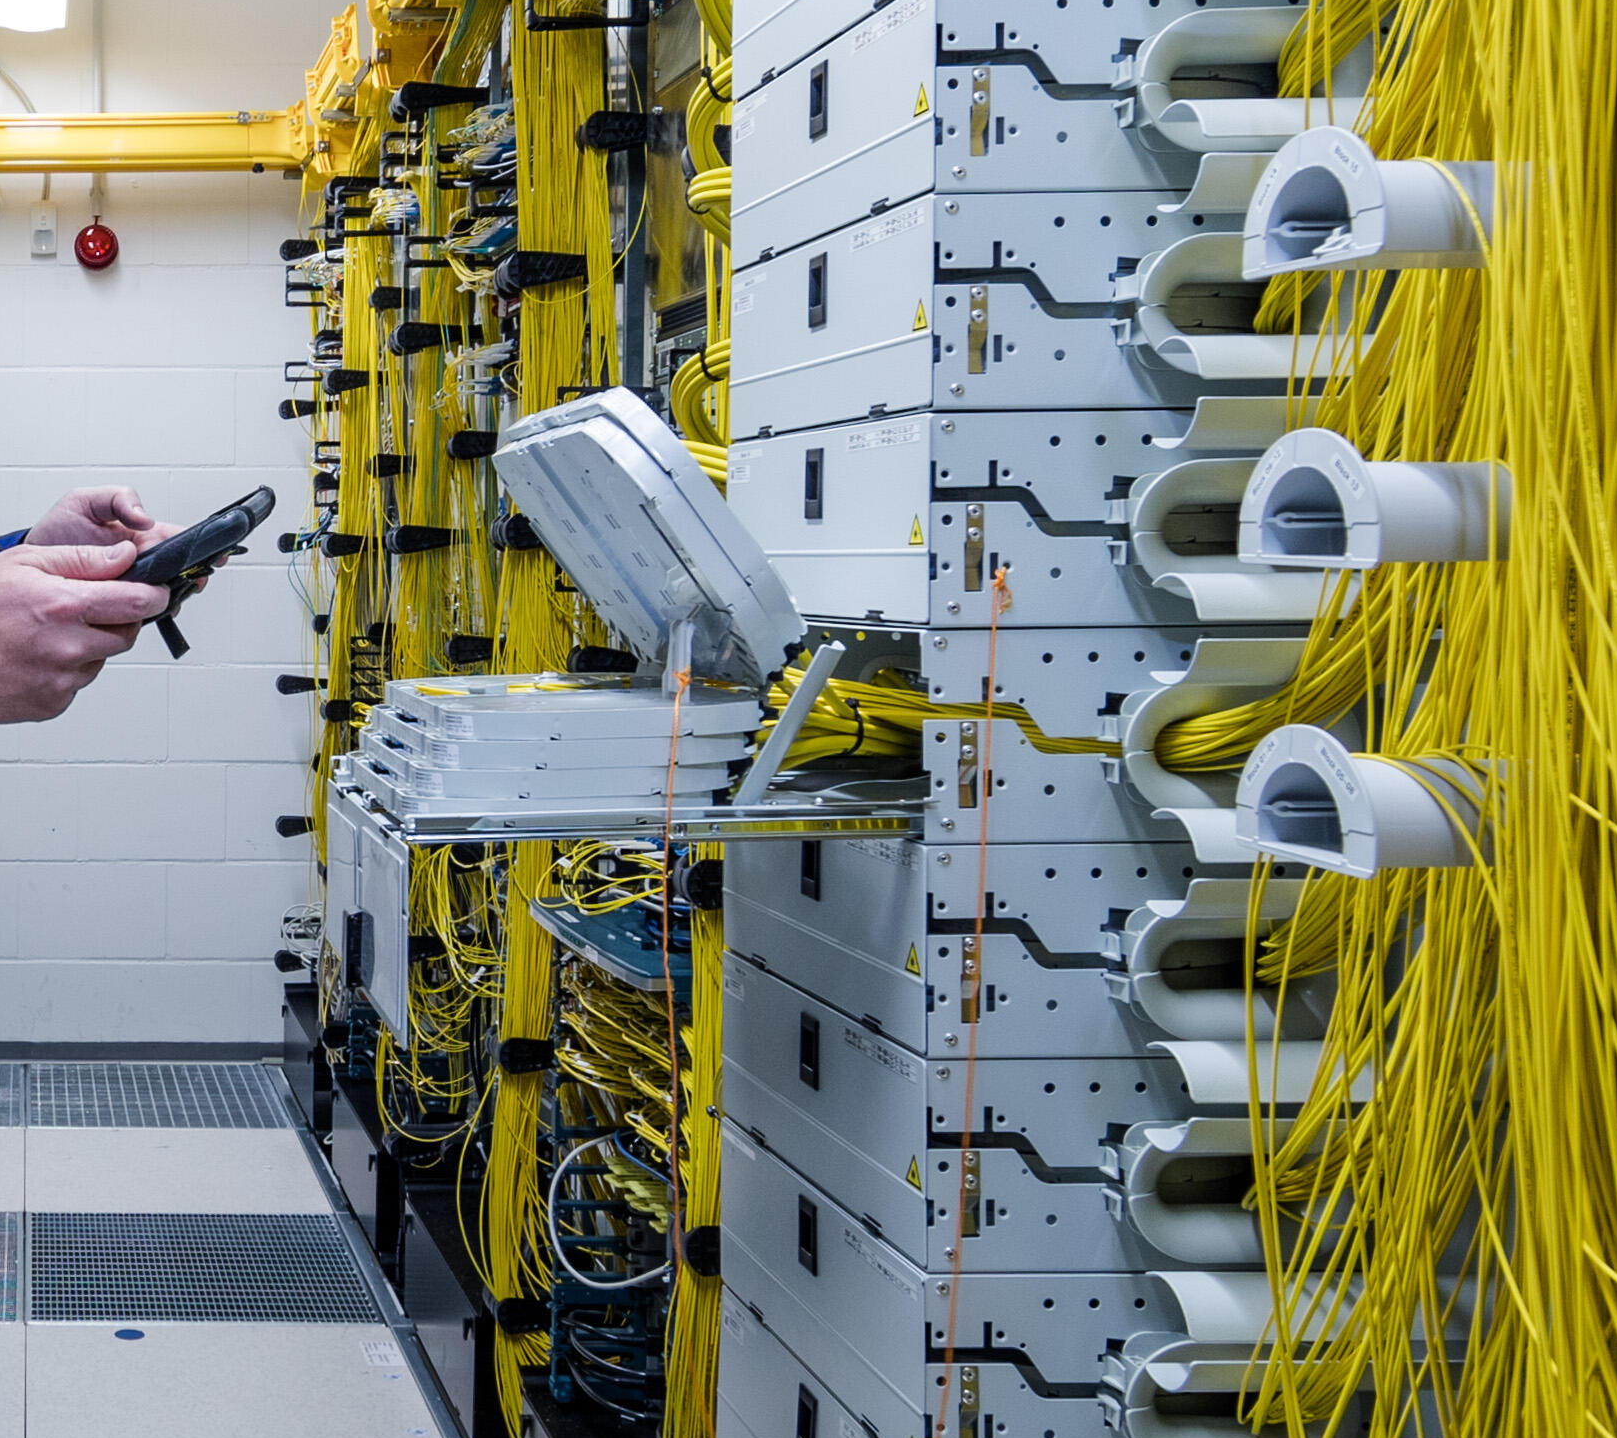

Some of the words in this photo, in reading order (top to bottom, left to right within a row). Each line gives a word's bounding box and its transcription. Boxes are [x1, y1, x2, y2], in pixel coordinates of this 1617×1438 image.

[1334, 145, 1350, 163] Block
[1334, 458, 1350, 480] Block
[1320, 746, 1336, 769] Block
